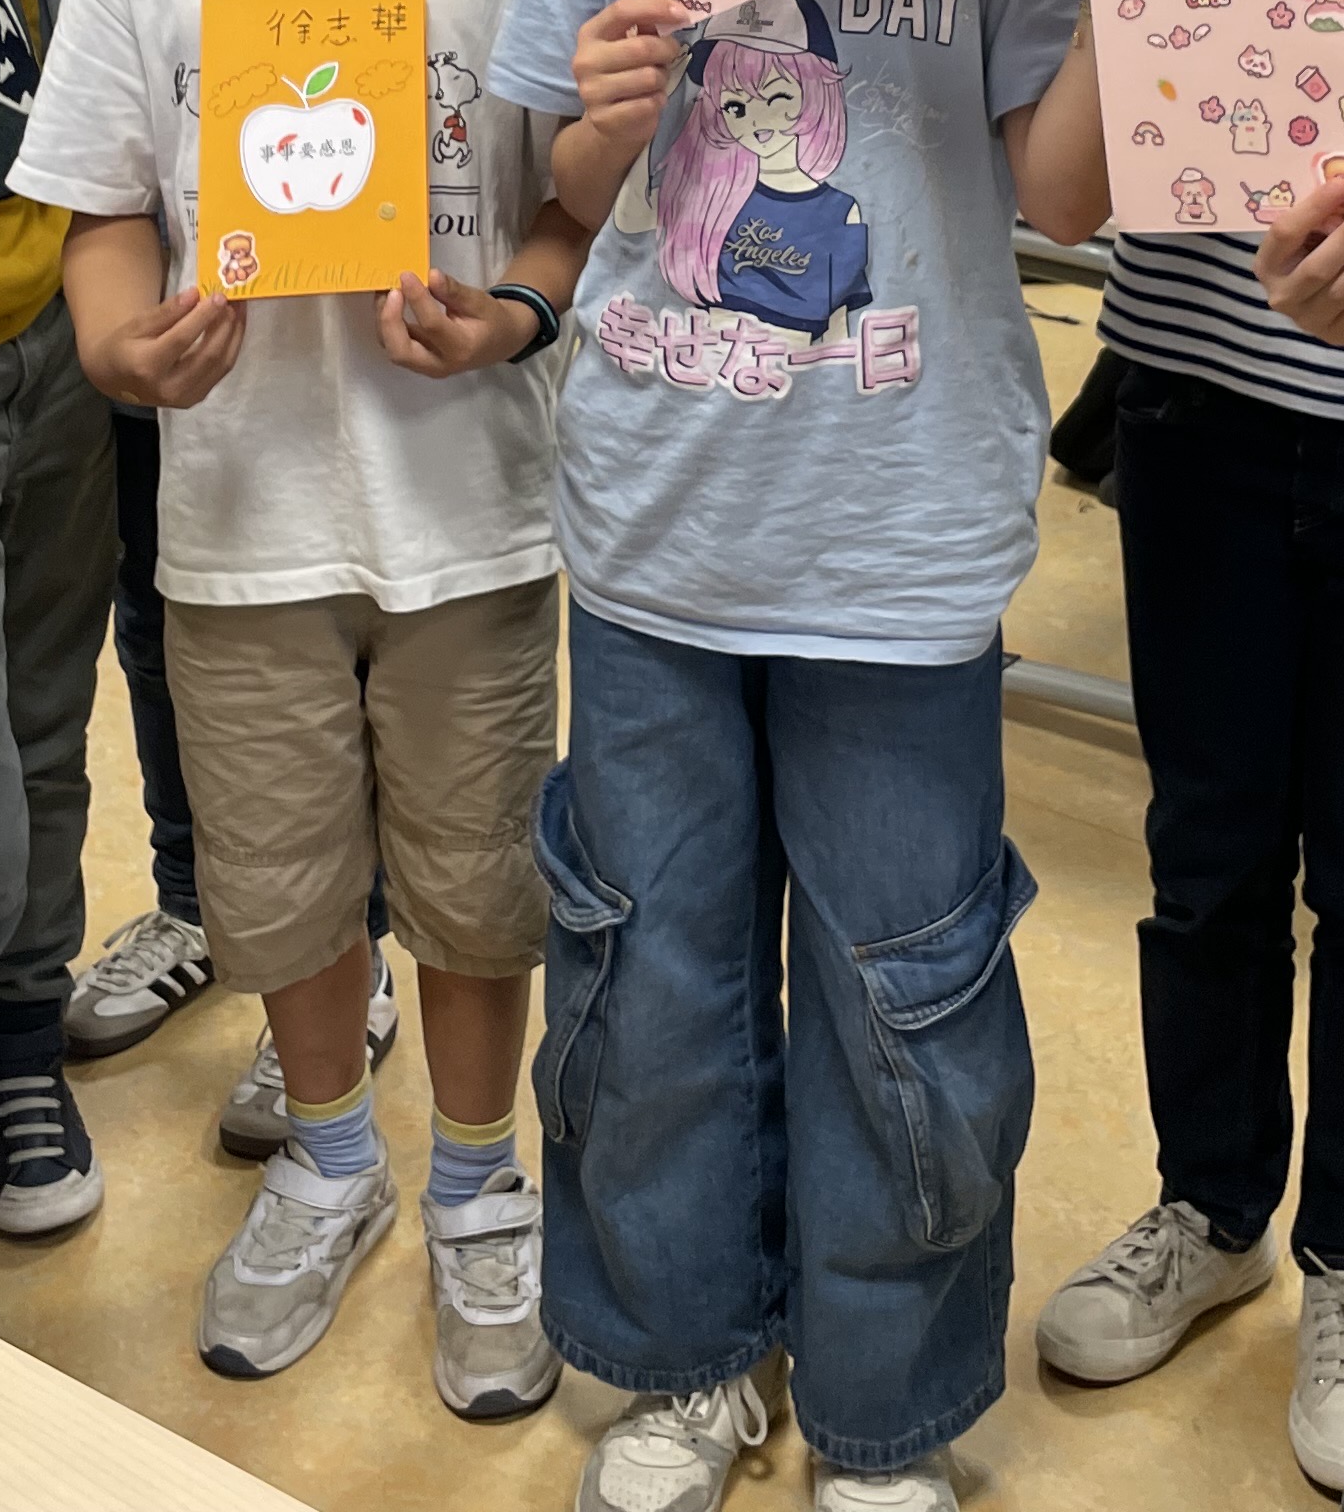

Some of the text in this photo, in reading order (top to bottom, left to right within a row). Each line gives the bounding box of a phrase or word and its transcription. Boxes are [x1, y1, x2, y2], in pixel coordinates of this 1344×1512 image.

[259, 137, 357, 164] 事事要感恩
[738, 216, 783, 242] Los
[725, 237, 813, 275] Angeles
[599, 294, 920, 397] 幸せな一日
